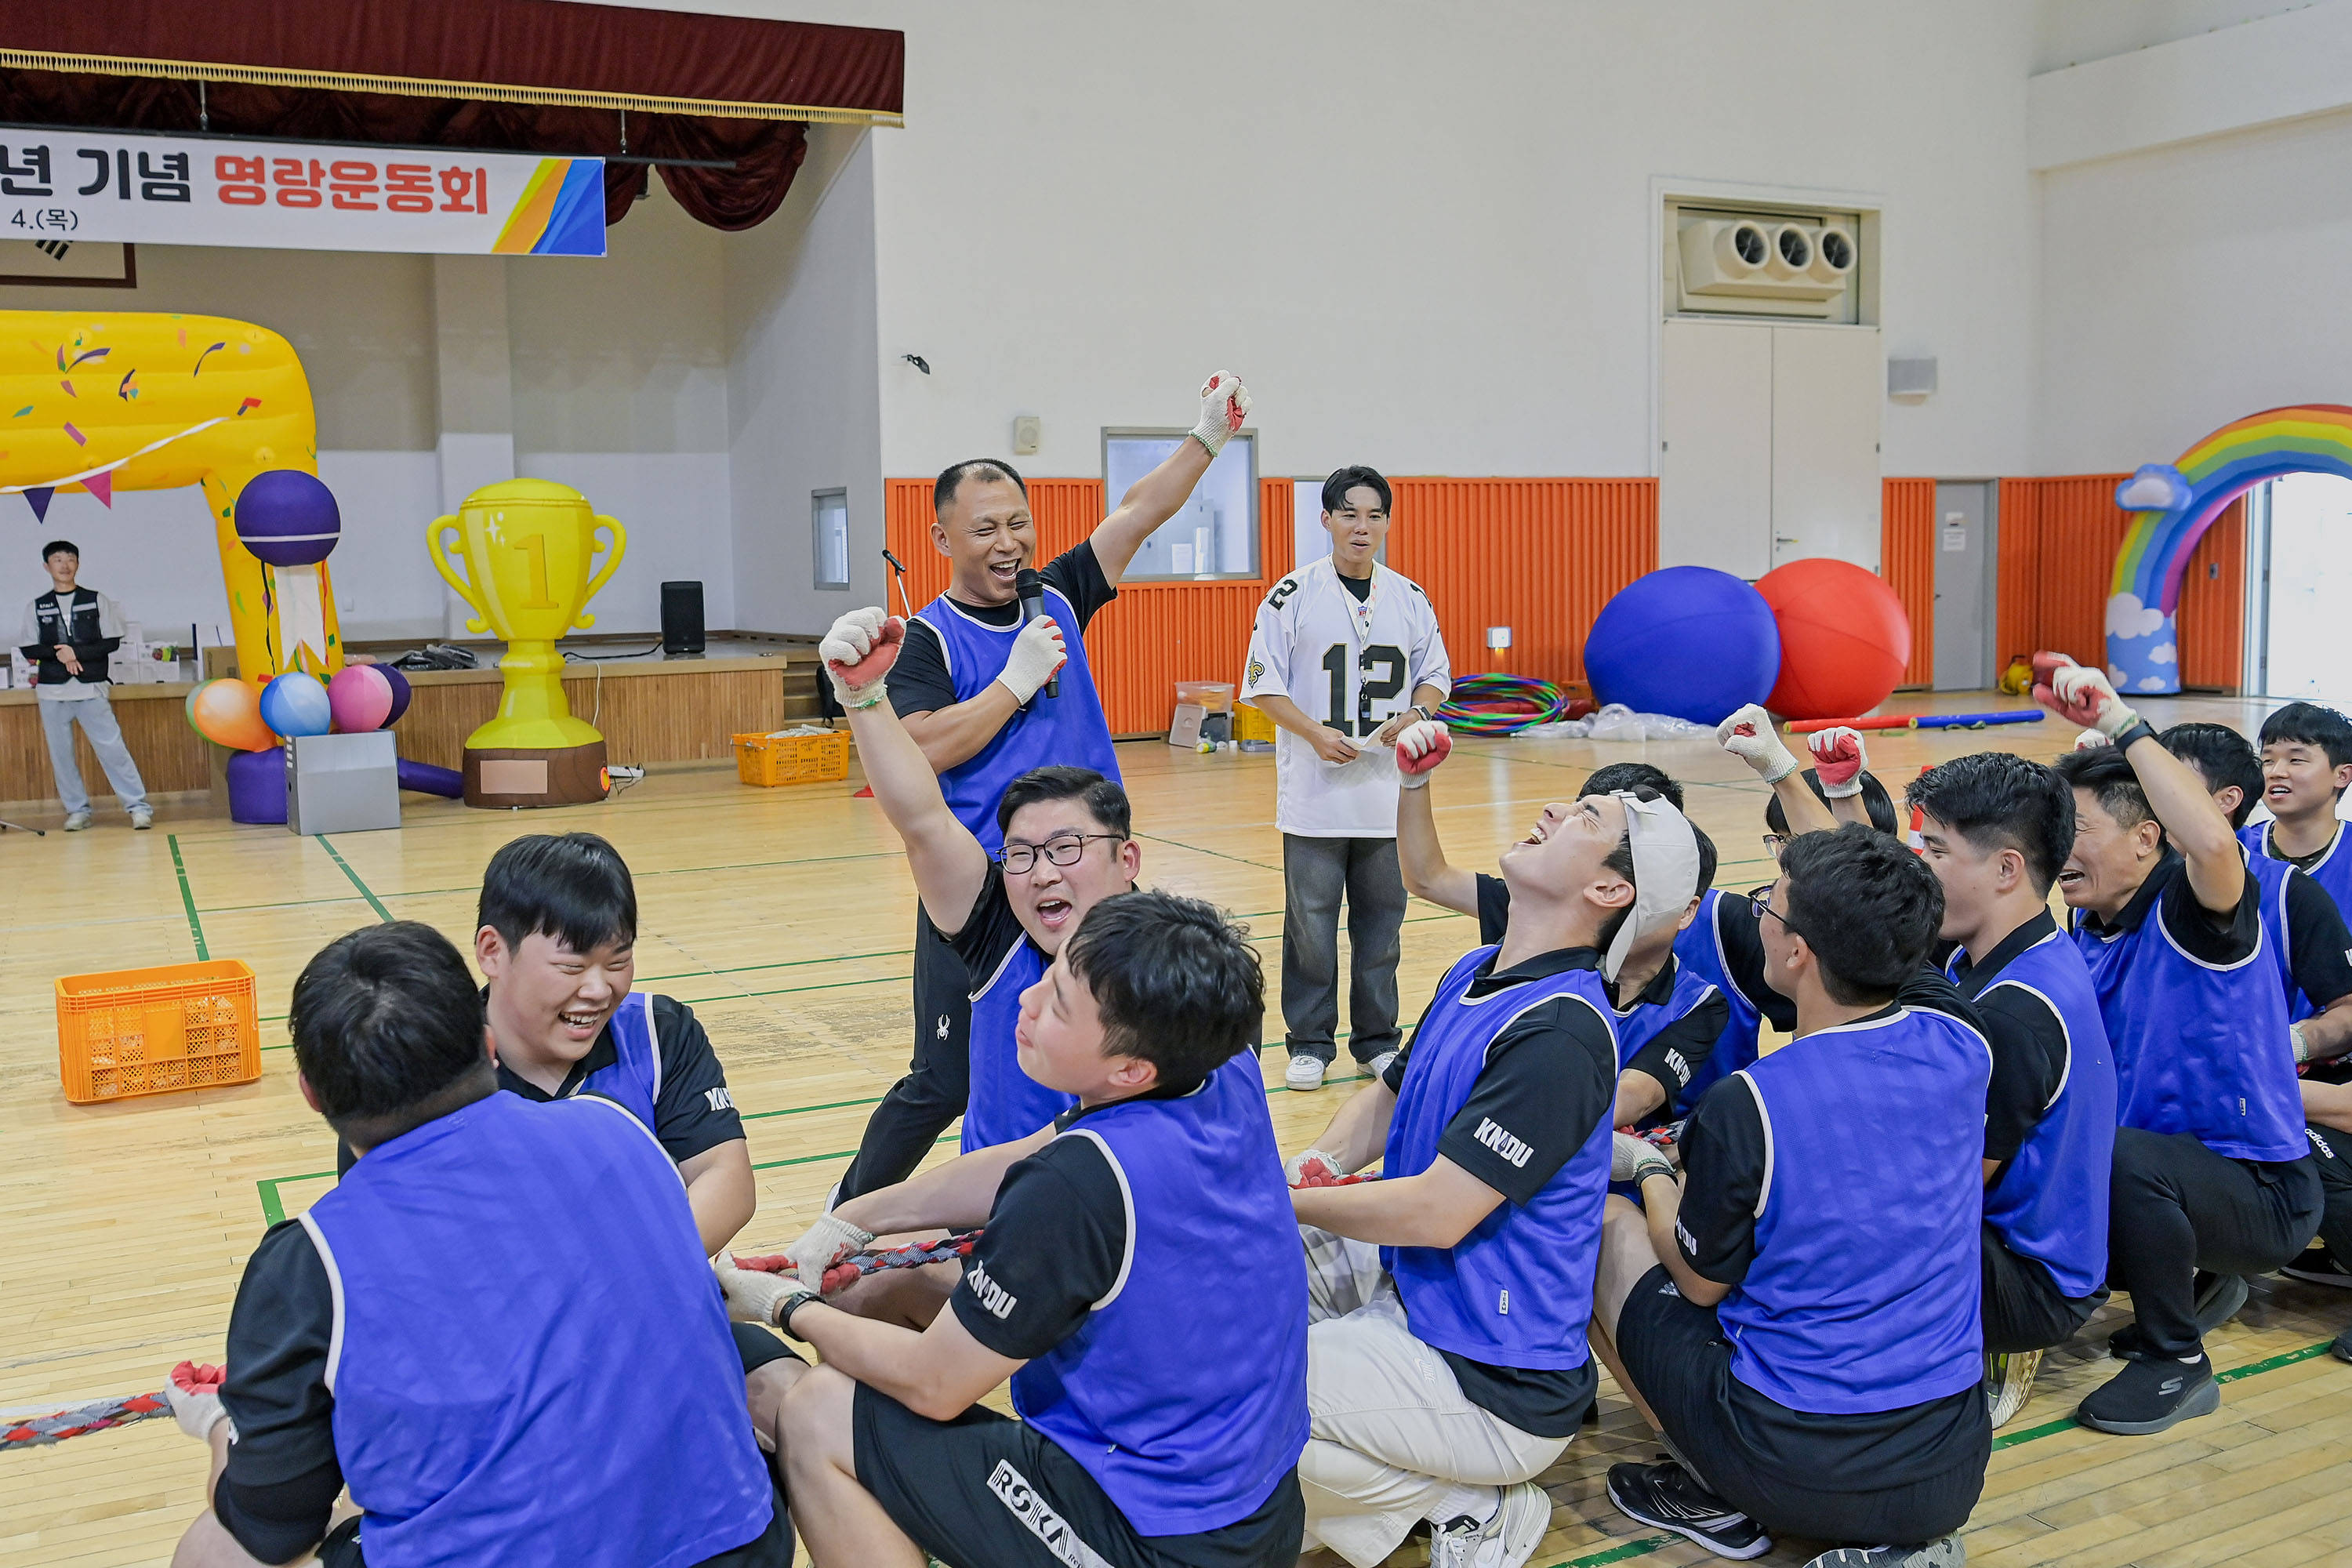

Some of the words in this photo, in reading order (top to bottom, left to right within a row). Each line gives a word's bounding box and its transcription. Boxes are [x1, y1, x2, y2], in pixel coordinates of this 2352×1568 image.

[0, 144, 53, 196] 년
[77, 148, 191, 202] 기념
[215, 155, 488, 214] 명랑운동회
[11, 209, 78, 230] 4.(목)
[513, 534, 559, 609] 1
[1321, 642, 1407, 738] 12
[1664, 1047, 1691, 1088] KNDU
[1473, 1116, 1534, 1168] KNDU
[2304, 1128, 2334, 1159] adidas
[1675, 1214, 1697, 1256] NDU
